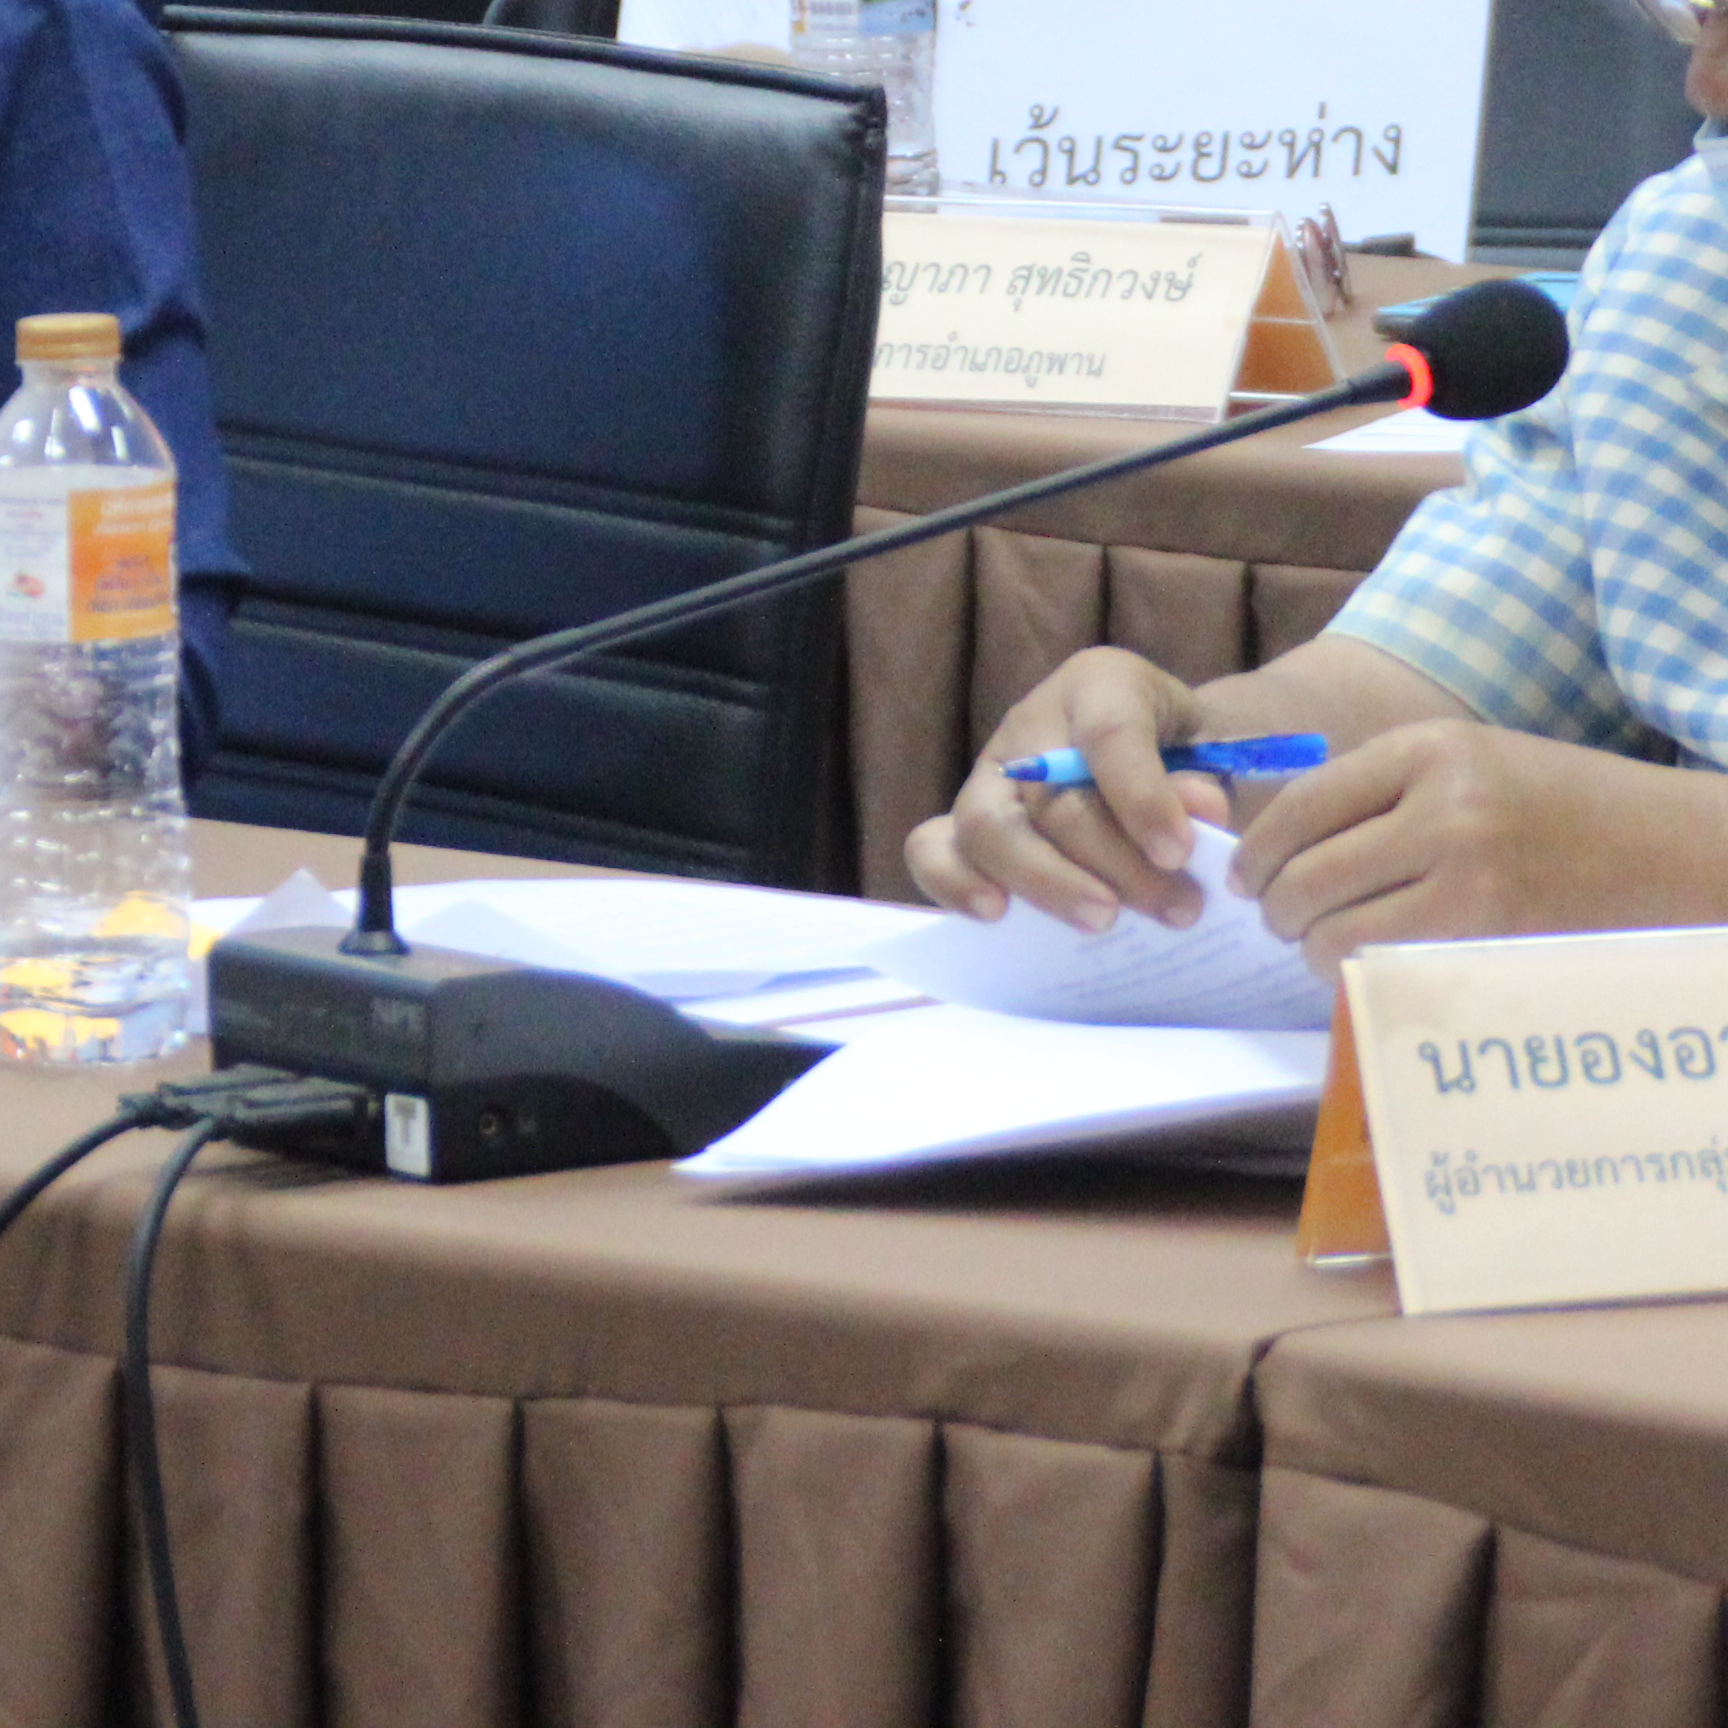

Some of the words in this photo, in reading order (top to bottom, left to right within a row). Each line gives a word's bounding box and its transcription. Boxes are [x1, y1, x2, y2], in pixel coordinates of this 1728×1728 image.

[987, 101, 1403, 188] เว้นระยะห่าง
[1005, 251, 1202, 313] สุทธิกวงษ์
